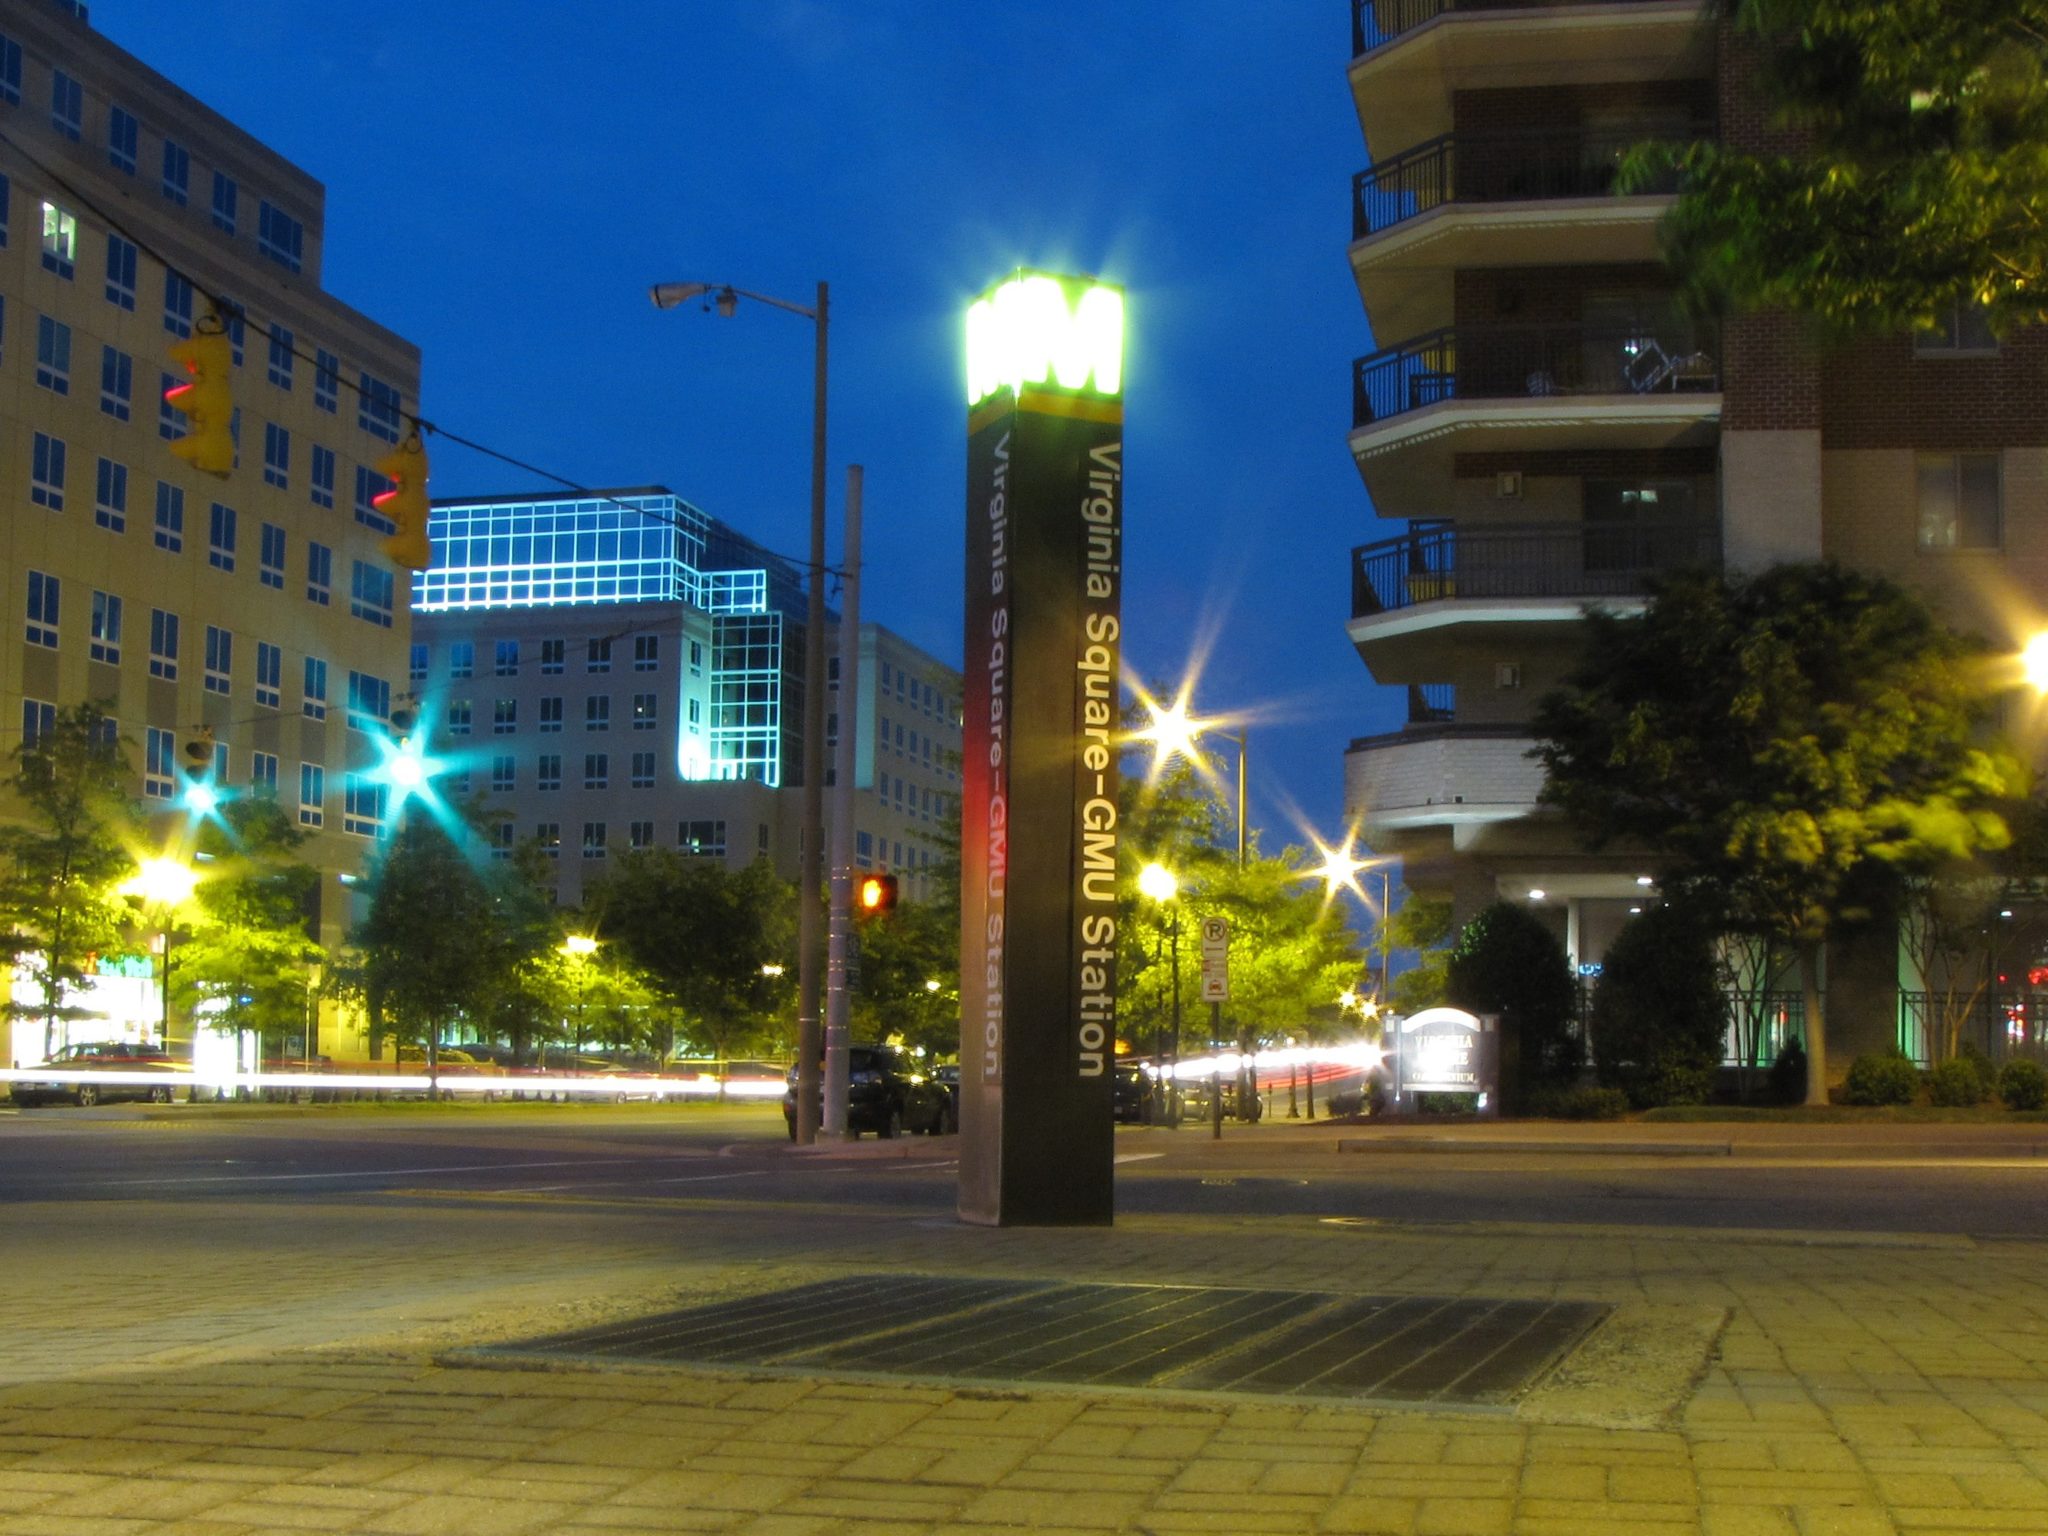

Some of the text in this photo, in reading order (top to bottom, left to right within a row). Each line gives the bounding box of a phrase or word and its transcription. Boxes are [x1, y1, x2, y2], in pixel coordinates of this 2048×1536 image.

[984, 431, 1010, 1076] Virginia Square-GMU Station
[1077, 441, 1121, 1077] Virginia Square-GMU Station
